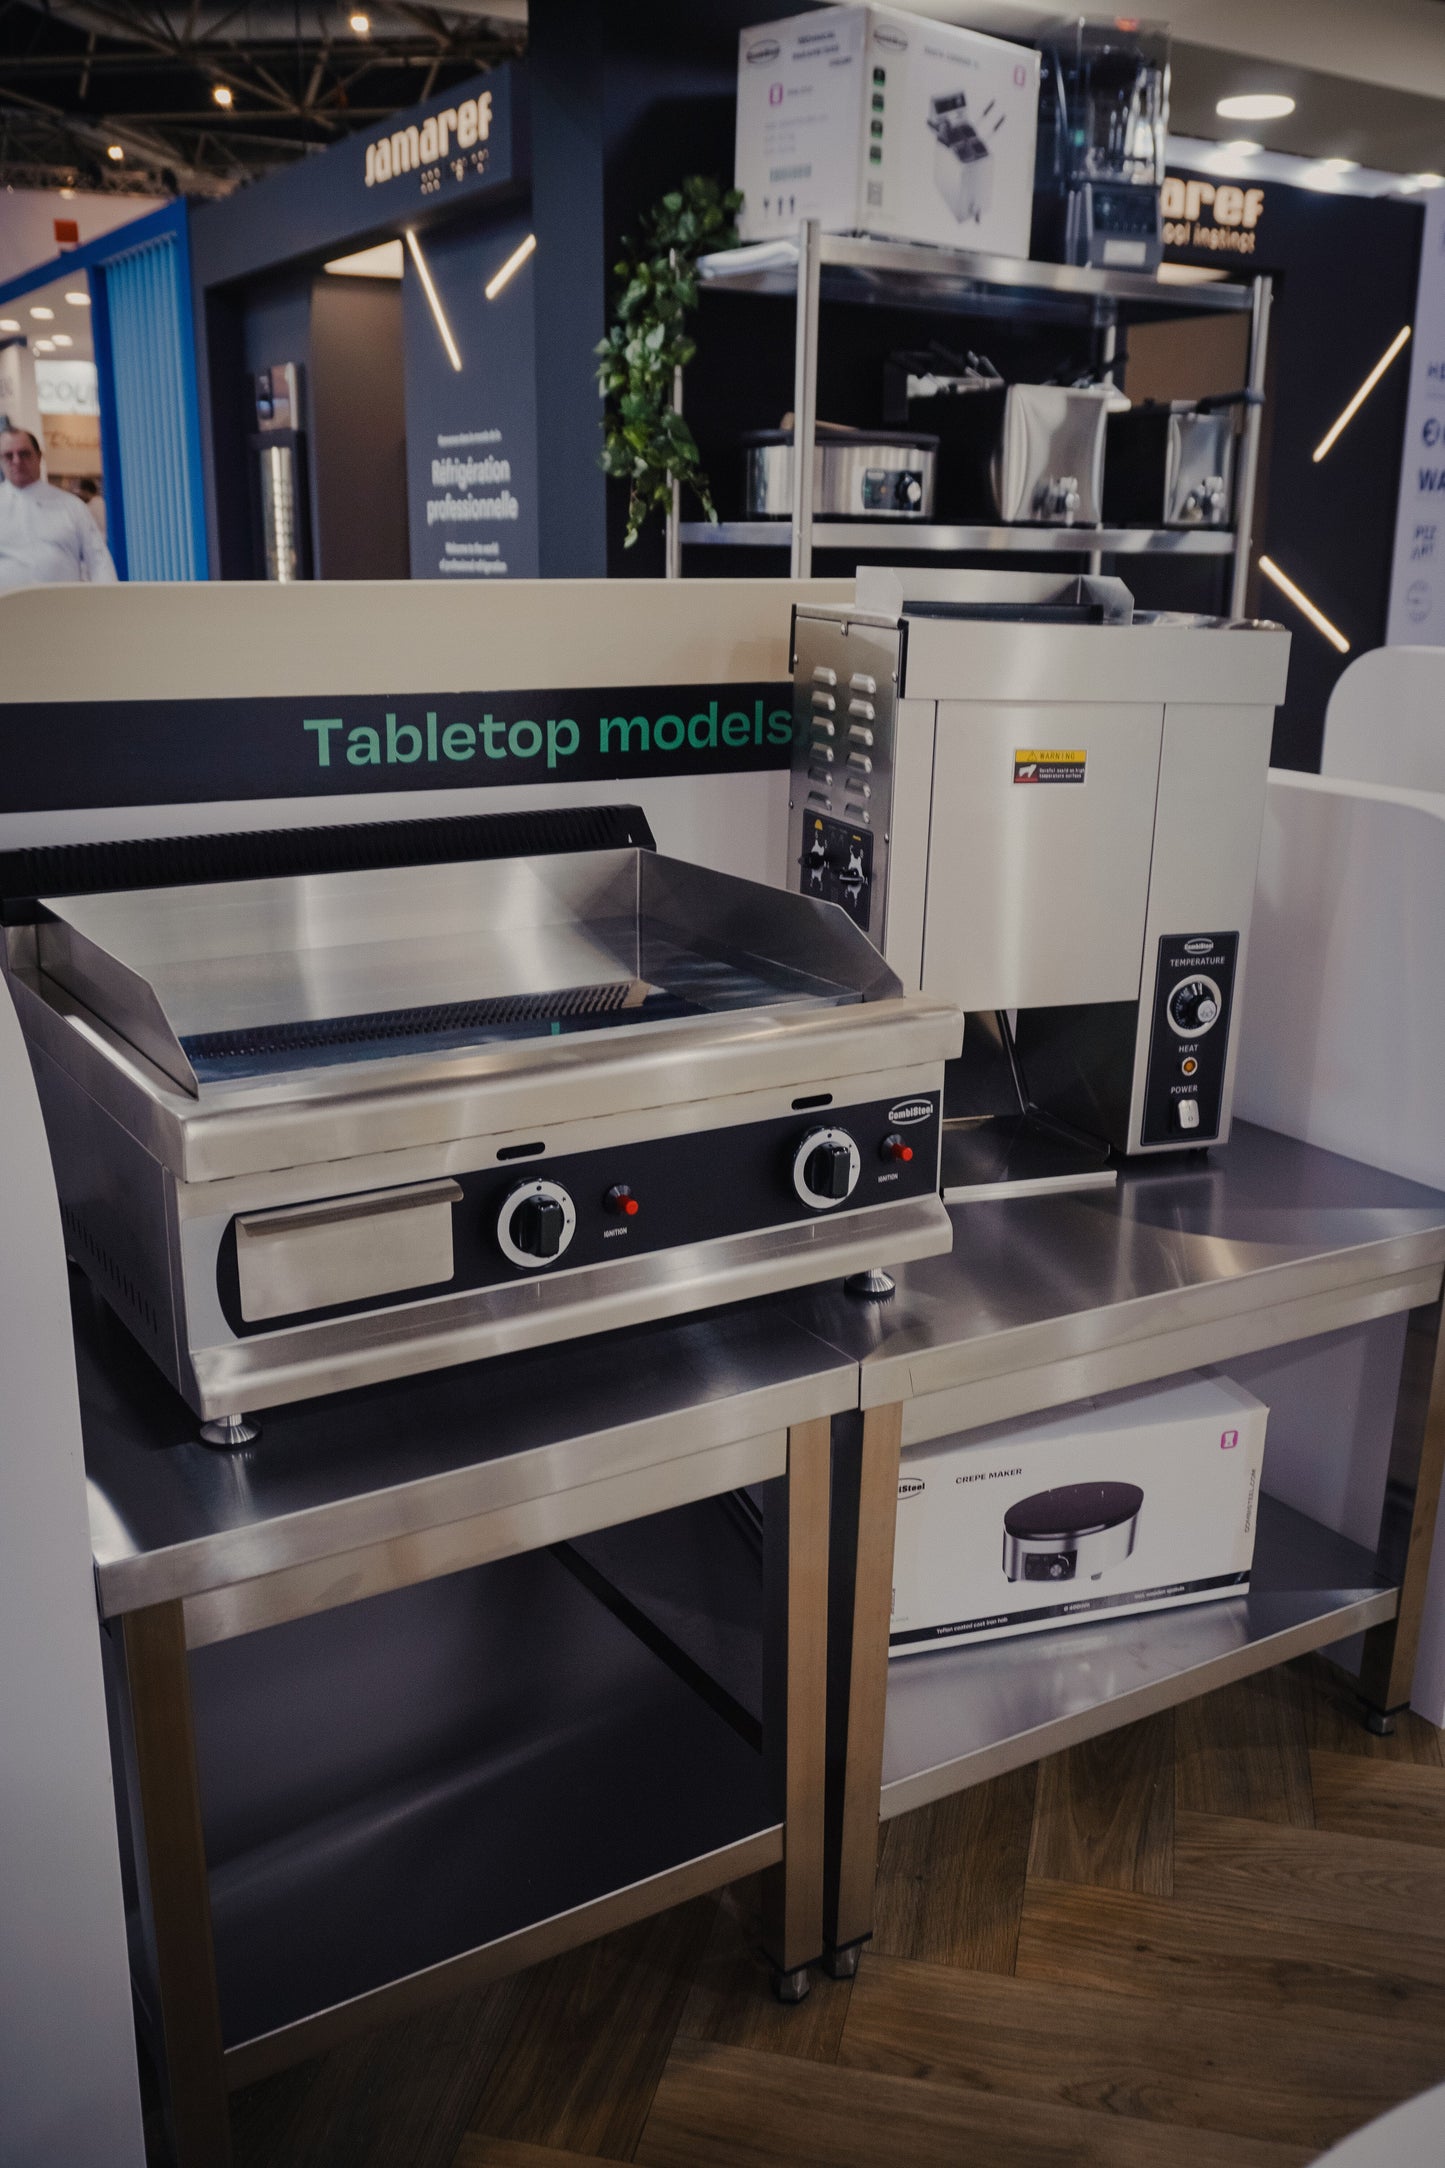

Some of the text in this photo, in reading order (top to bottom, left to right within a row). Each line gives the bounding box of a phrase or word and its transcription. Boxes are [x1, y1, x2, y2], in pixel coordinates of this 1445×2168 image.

[1160, 177, 1264, 228] aref
[1162, 222, 1191, 247] ool
[303, 700, 793, 769] Tabletop models
[1040, 751, 1075, 760] WARNING
[1169, 956, 1225, 967] TEMPERATURE
[1178, 1044, 1199, 1053] HEAT
[1170, 1085, 1198, 1094] POWER
[888, 1103, 934, 1121] CombiSteel
[877, 1173, 899, 1183] IGNITION
[603, 1227, 628, 1239] IGNITION
[955, 1468, 1022, 1485] CREPE MAKER
[898, 1482, 925, 1494] iSteel
